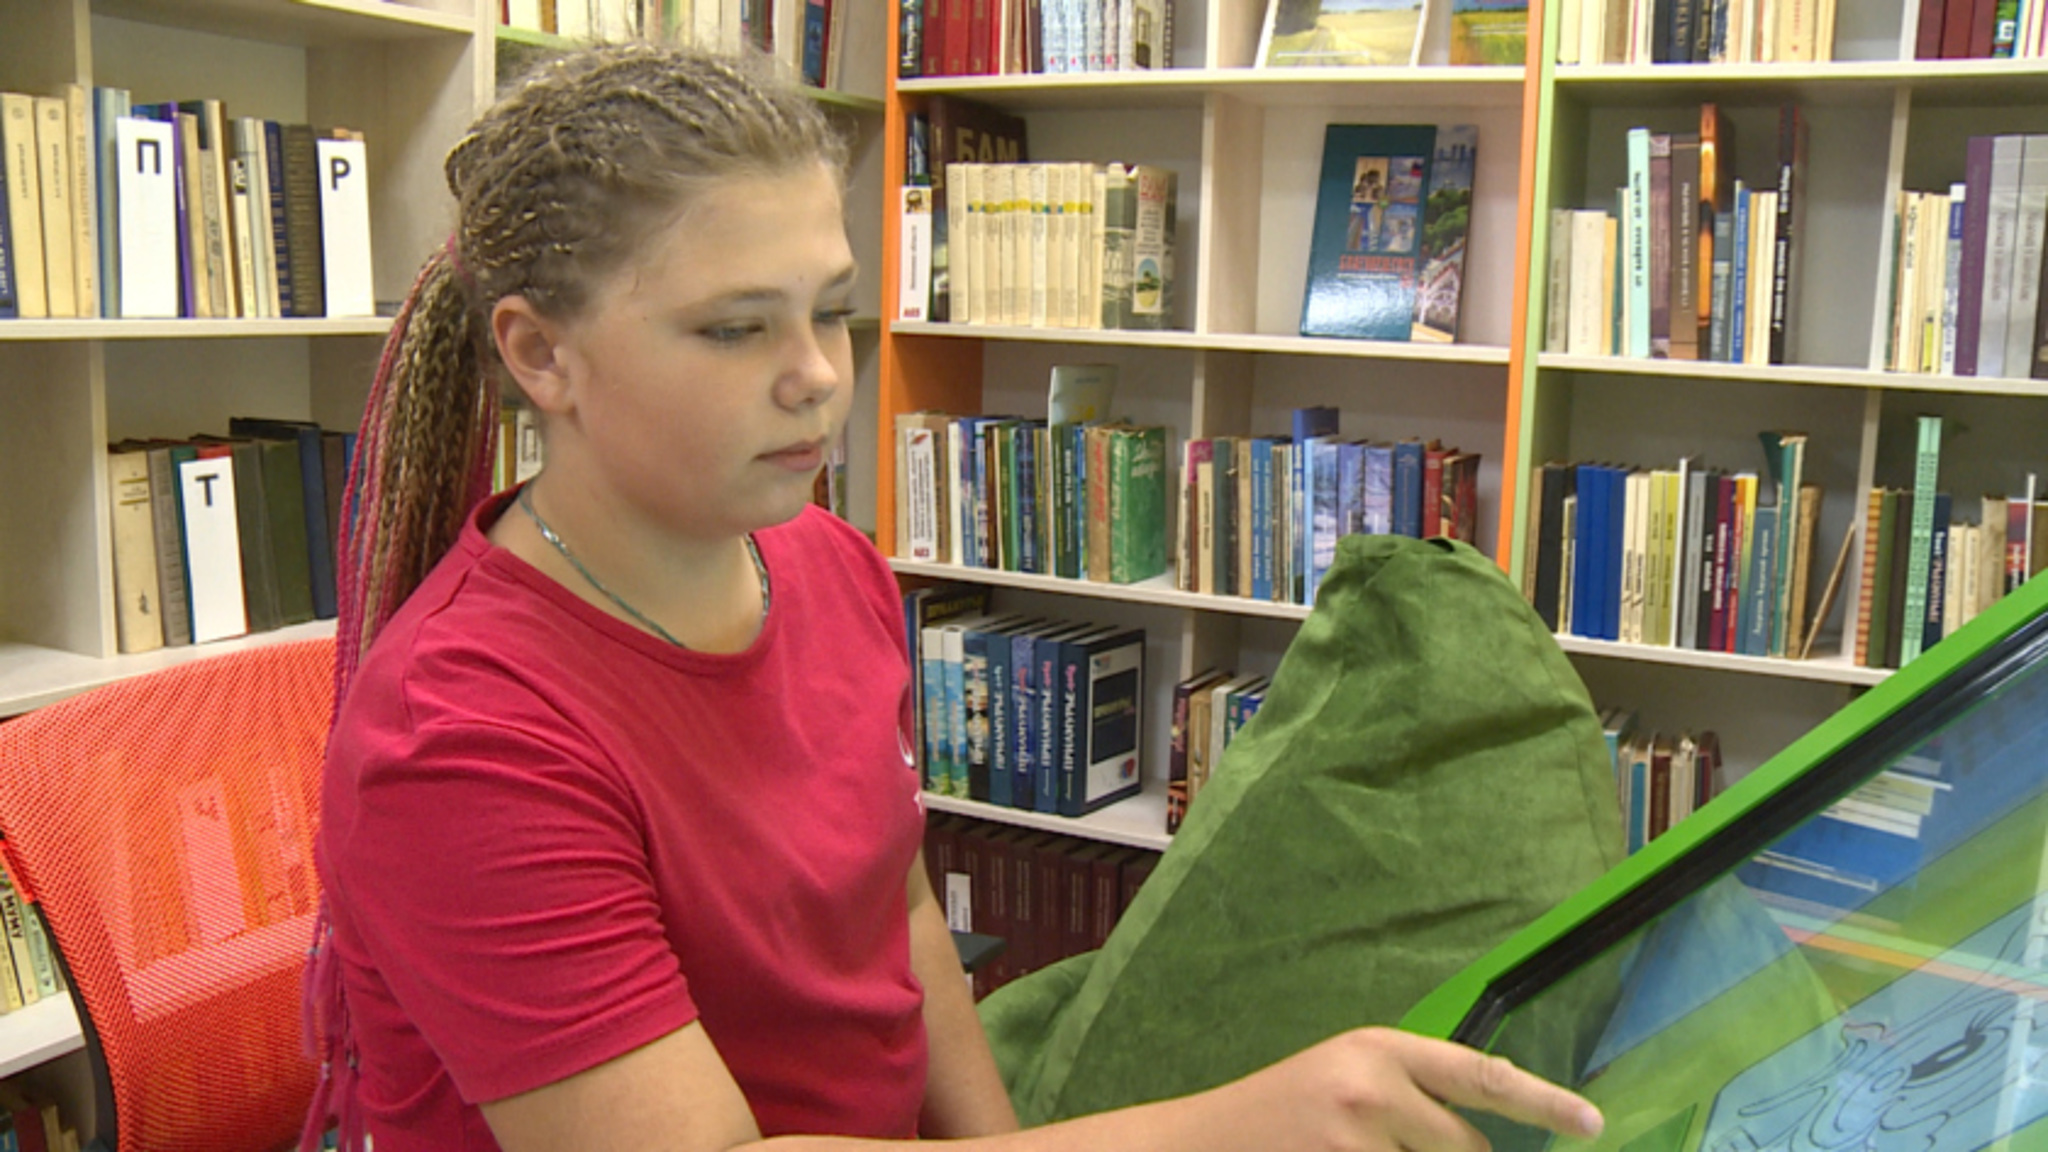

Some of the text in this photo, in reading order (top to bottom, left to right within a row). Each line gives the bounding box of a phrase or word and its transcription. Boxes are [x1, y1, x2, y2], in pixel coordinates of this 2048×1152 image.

[136, 138, 161, 175] П
[956, 126, 1018, 162] БАМ
[330, 157, 351, 191] Р
[195, 473, 219, 507] Т
